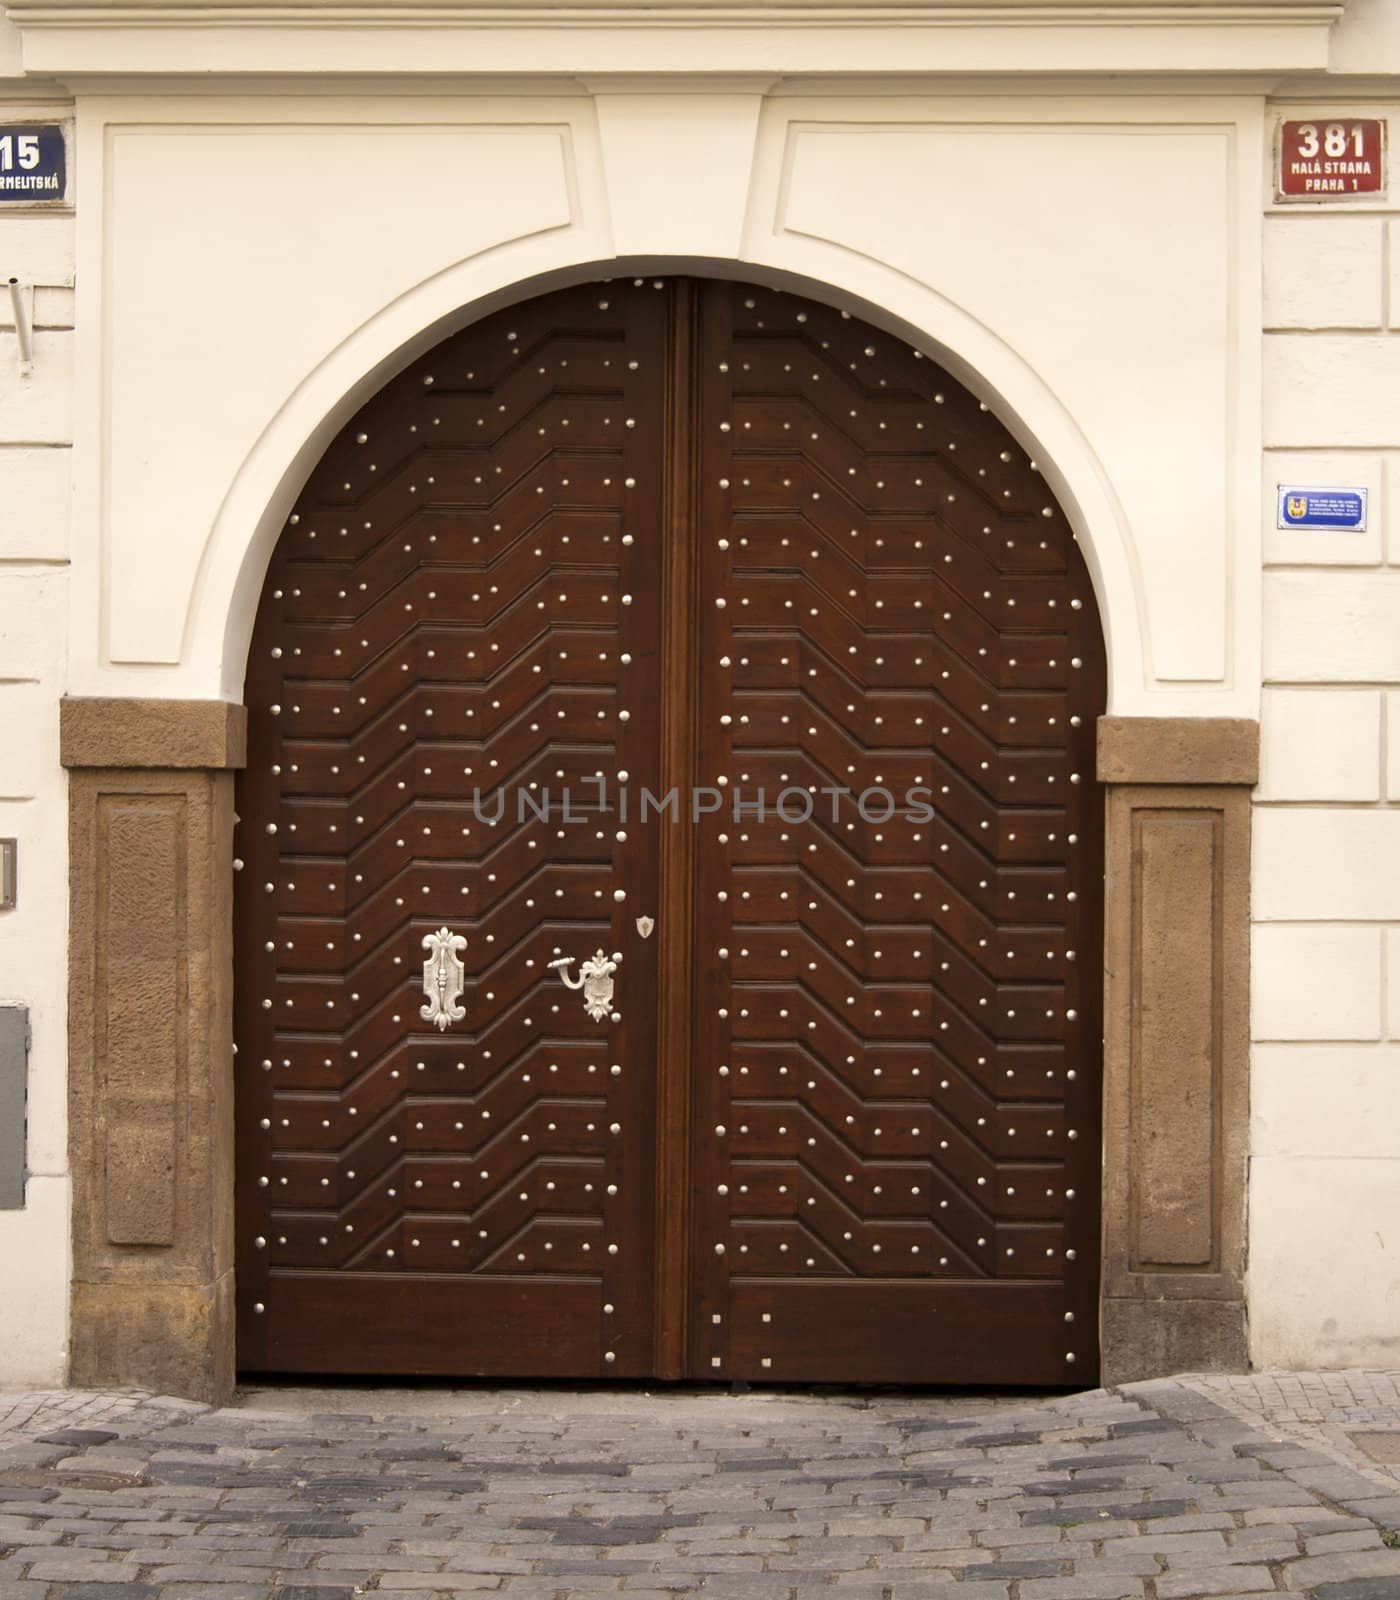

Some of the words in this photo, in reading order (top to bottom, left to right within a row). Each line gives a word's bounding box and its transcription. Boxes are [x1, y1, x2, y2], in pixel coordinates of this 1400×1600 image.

[0, 135, 40, 170] 15
[1297, 123, 1364, 158] 381
[1291, 159, 1321, 174] MALÁ
[1324, 162, 1371, 174] STRANA
[1305, 179, 1345, 191] PRAHA
[1351, 178, 1358, 191] 1
